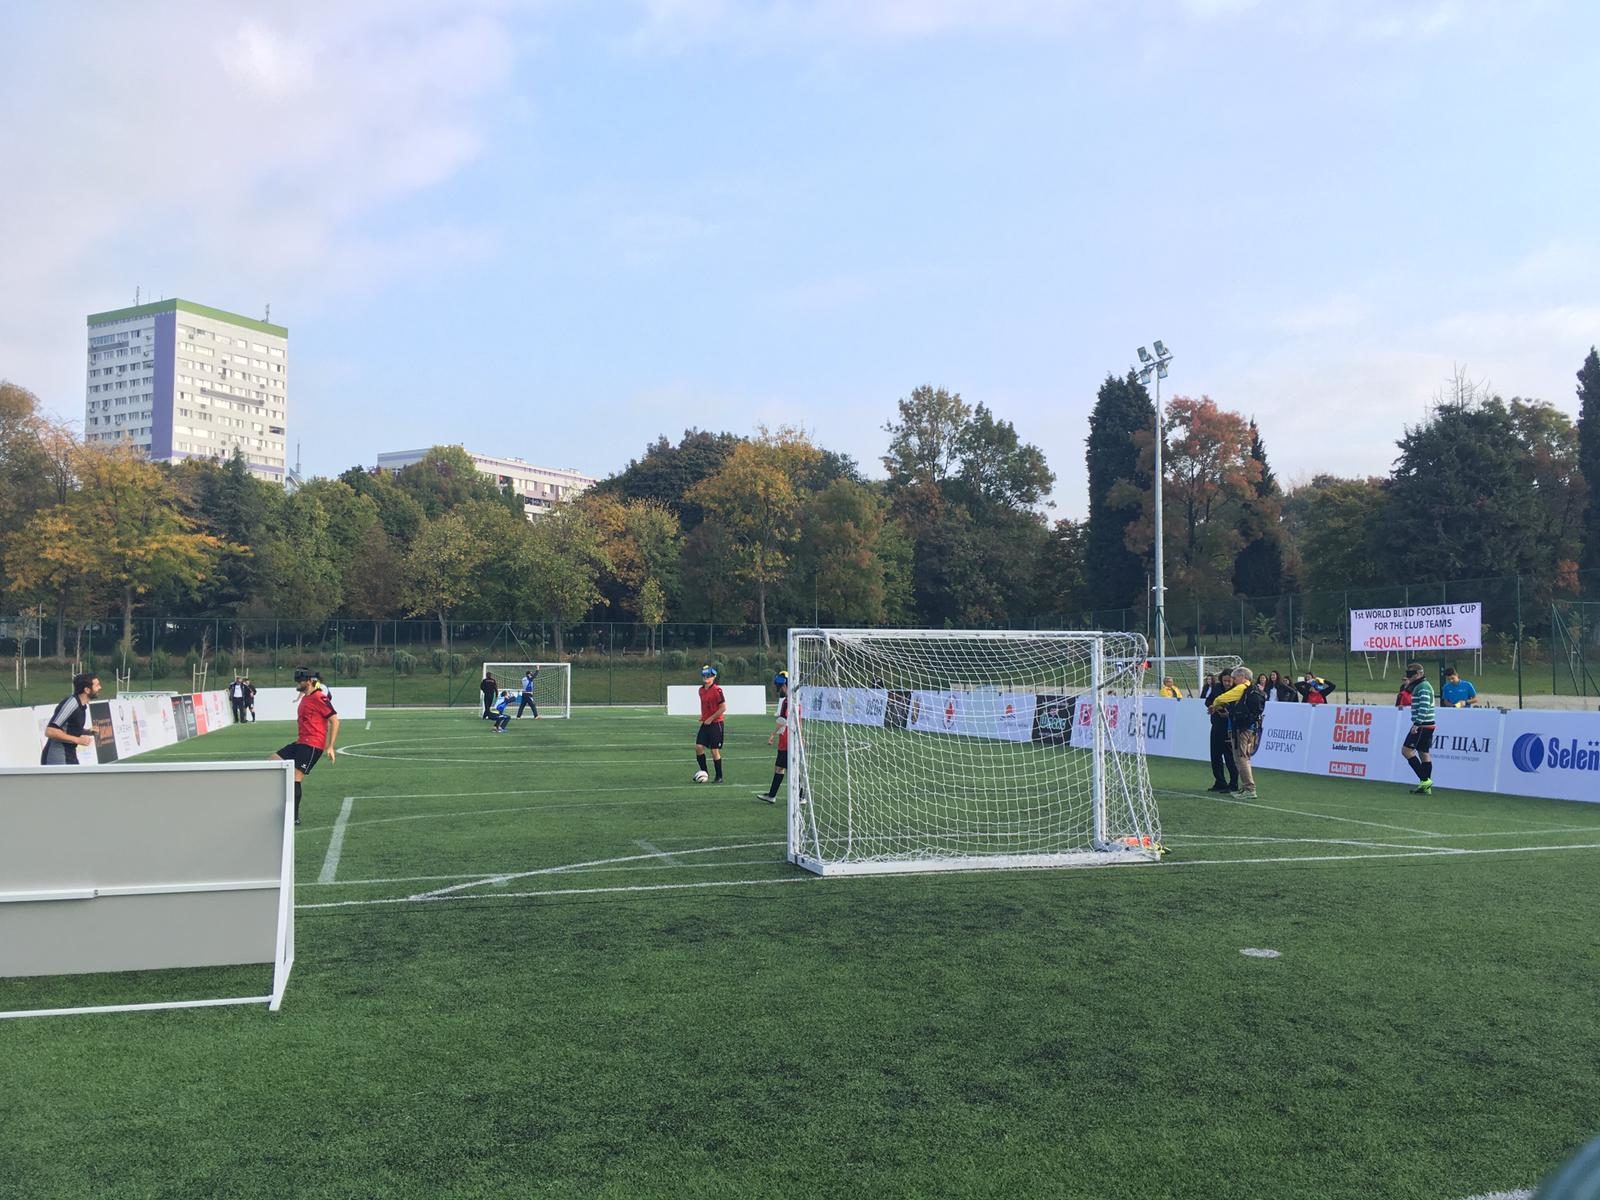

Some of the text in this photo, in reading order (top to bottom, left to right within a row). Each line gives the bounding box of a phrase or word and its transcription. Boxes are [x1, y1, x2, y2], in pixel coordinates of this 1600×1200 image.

[1354, 604, 1477, 620] 1st WORLD BLIND FOOTBALL CUP
[1374, 618, 1452, 631] FOR THE CLUB TEAMS
[1335, 706, 1372, 726] Little
[1267, 728, 1303, 741] ОБЩИНА
[1333, 724, 1370, 744] Giant
[1265, 740, 1296, 753] БУРГАС
[1432, 735, 1490, 754] ИГ ЩАЛ
